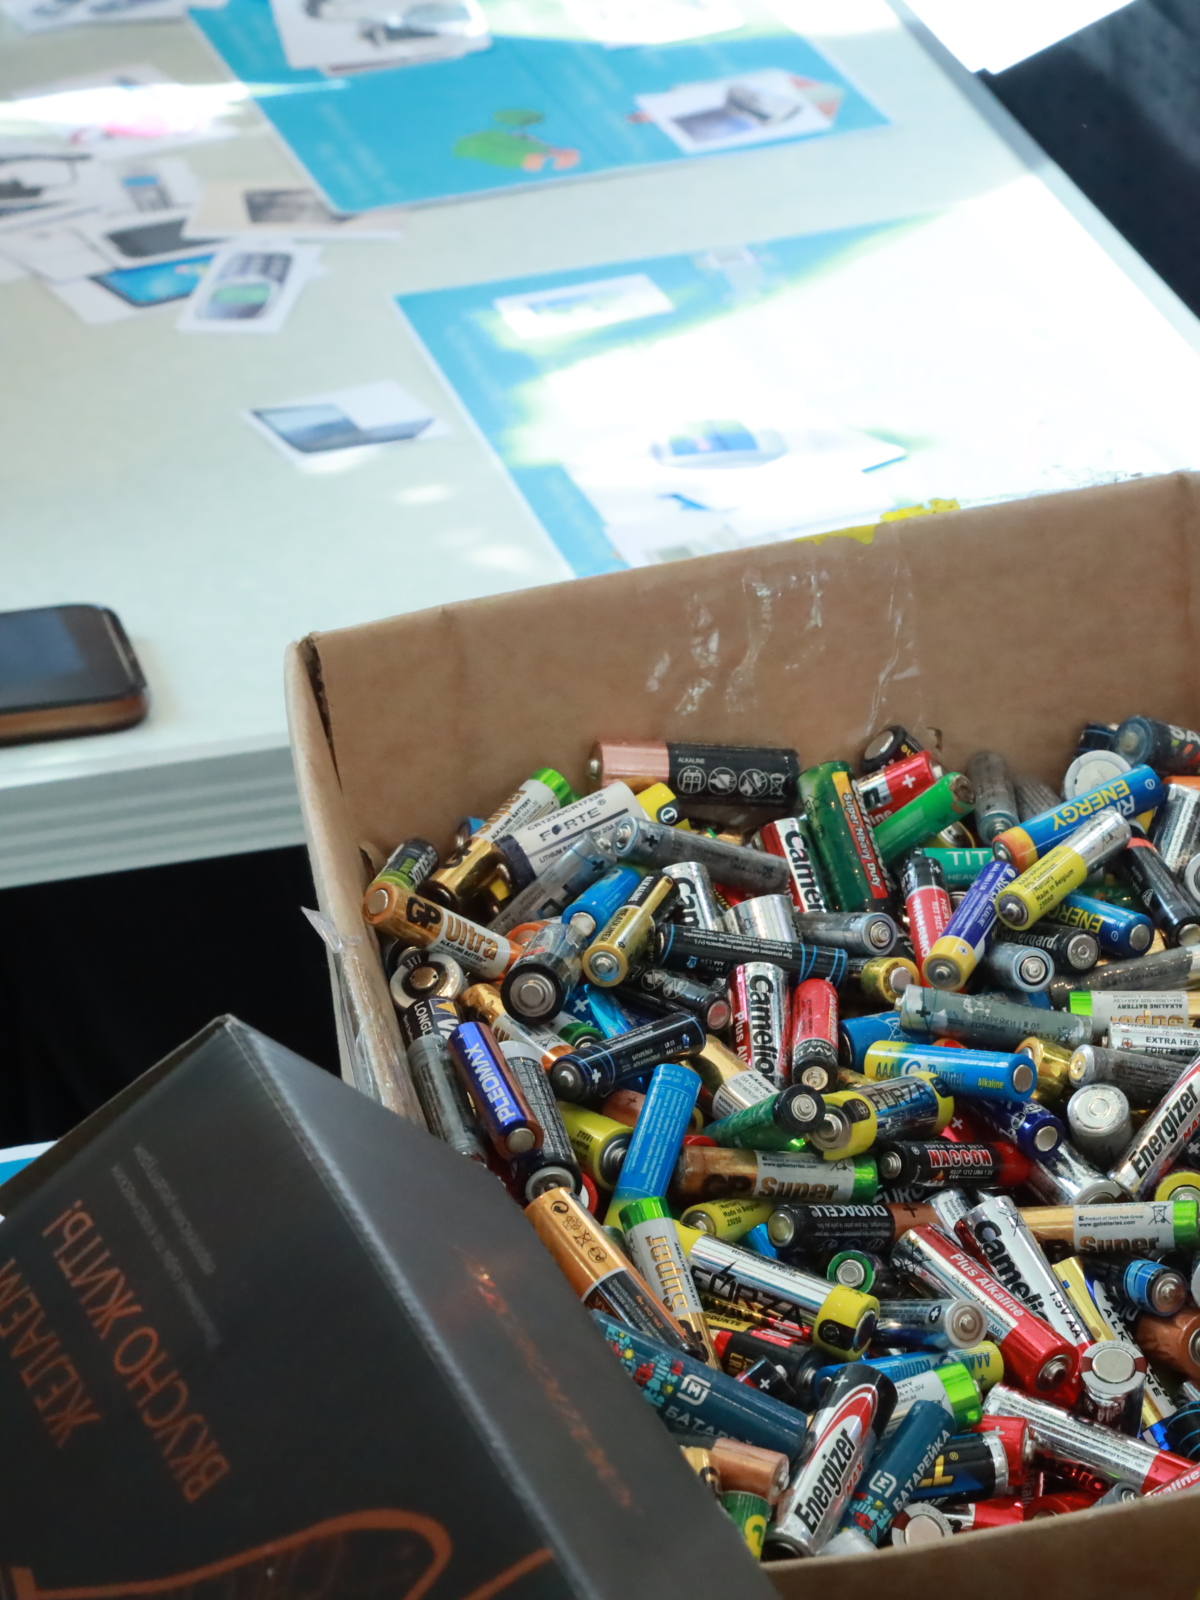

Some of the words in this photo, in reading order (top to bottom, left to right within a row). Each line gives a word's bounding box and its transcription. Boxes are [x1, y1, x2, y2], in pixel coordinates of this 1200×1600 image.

[1053, 779, 1132, 831] ENERGY
[840, 791, 862, 827] Super
[851, 825, 873, 861] Heavy
[864, 860, 883, 888] Duty
[1033, 887, 1050, 902] Made
[1052, 868, 1077, 888] Belgium
[406, 896, 443, 930] GP
[440, 939, 465, 956] ALKALINE
[445, 915, 498, 961] Ultra
[735, 1011, 745, 1043] Plus
[1146, 1036, 1177, 1046] EXTRA
[743, 1070, 776, 1096] ALKALINE
[875, 1061, 895, 1077] AAA
[977, 1077, 1004, 1089] Alkaline
[867, 1081, 932, 1113] FORZA
[1127, 1082, 1200, 1180] Energizer
[929, 1150, 993, 1169] NACCON
[758, 1177, 838, 1200] Super
[817, 1204, 889, 1218] DURACELL
[1079, 1220, 1136, 1228] www.gpbatteries.com
[42, 1199, 143, 1351] ЖИТЬ!
[645, 1234, 689, 1313] Super
[949, 1253, 977, 1278] Plus
[976, 1277, 1024, 1318] Alkaline
[690, 1263, 804, 1320] FORZA
[1049, 1290, 1067, 1317] 1.5V
[1066, 1316, 1081, 1340] AA
[112, 1322, 232, 1504] ВКУСНО
[795, 1427, 856, 1535] Energizer
[845, 1459, 865, 1494] MAX
[894, 1429, 951, 1511] БАТАРЕЙКА
